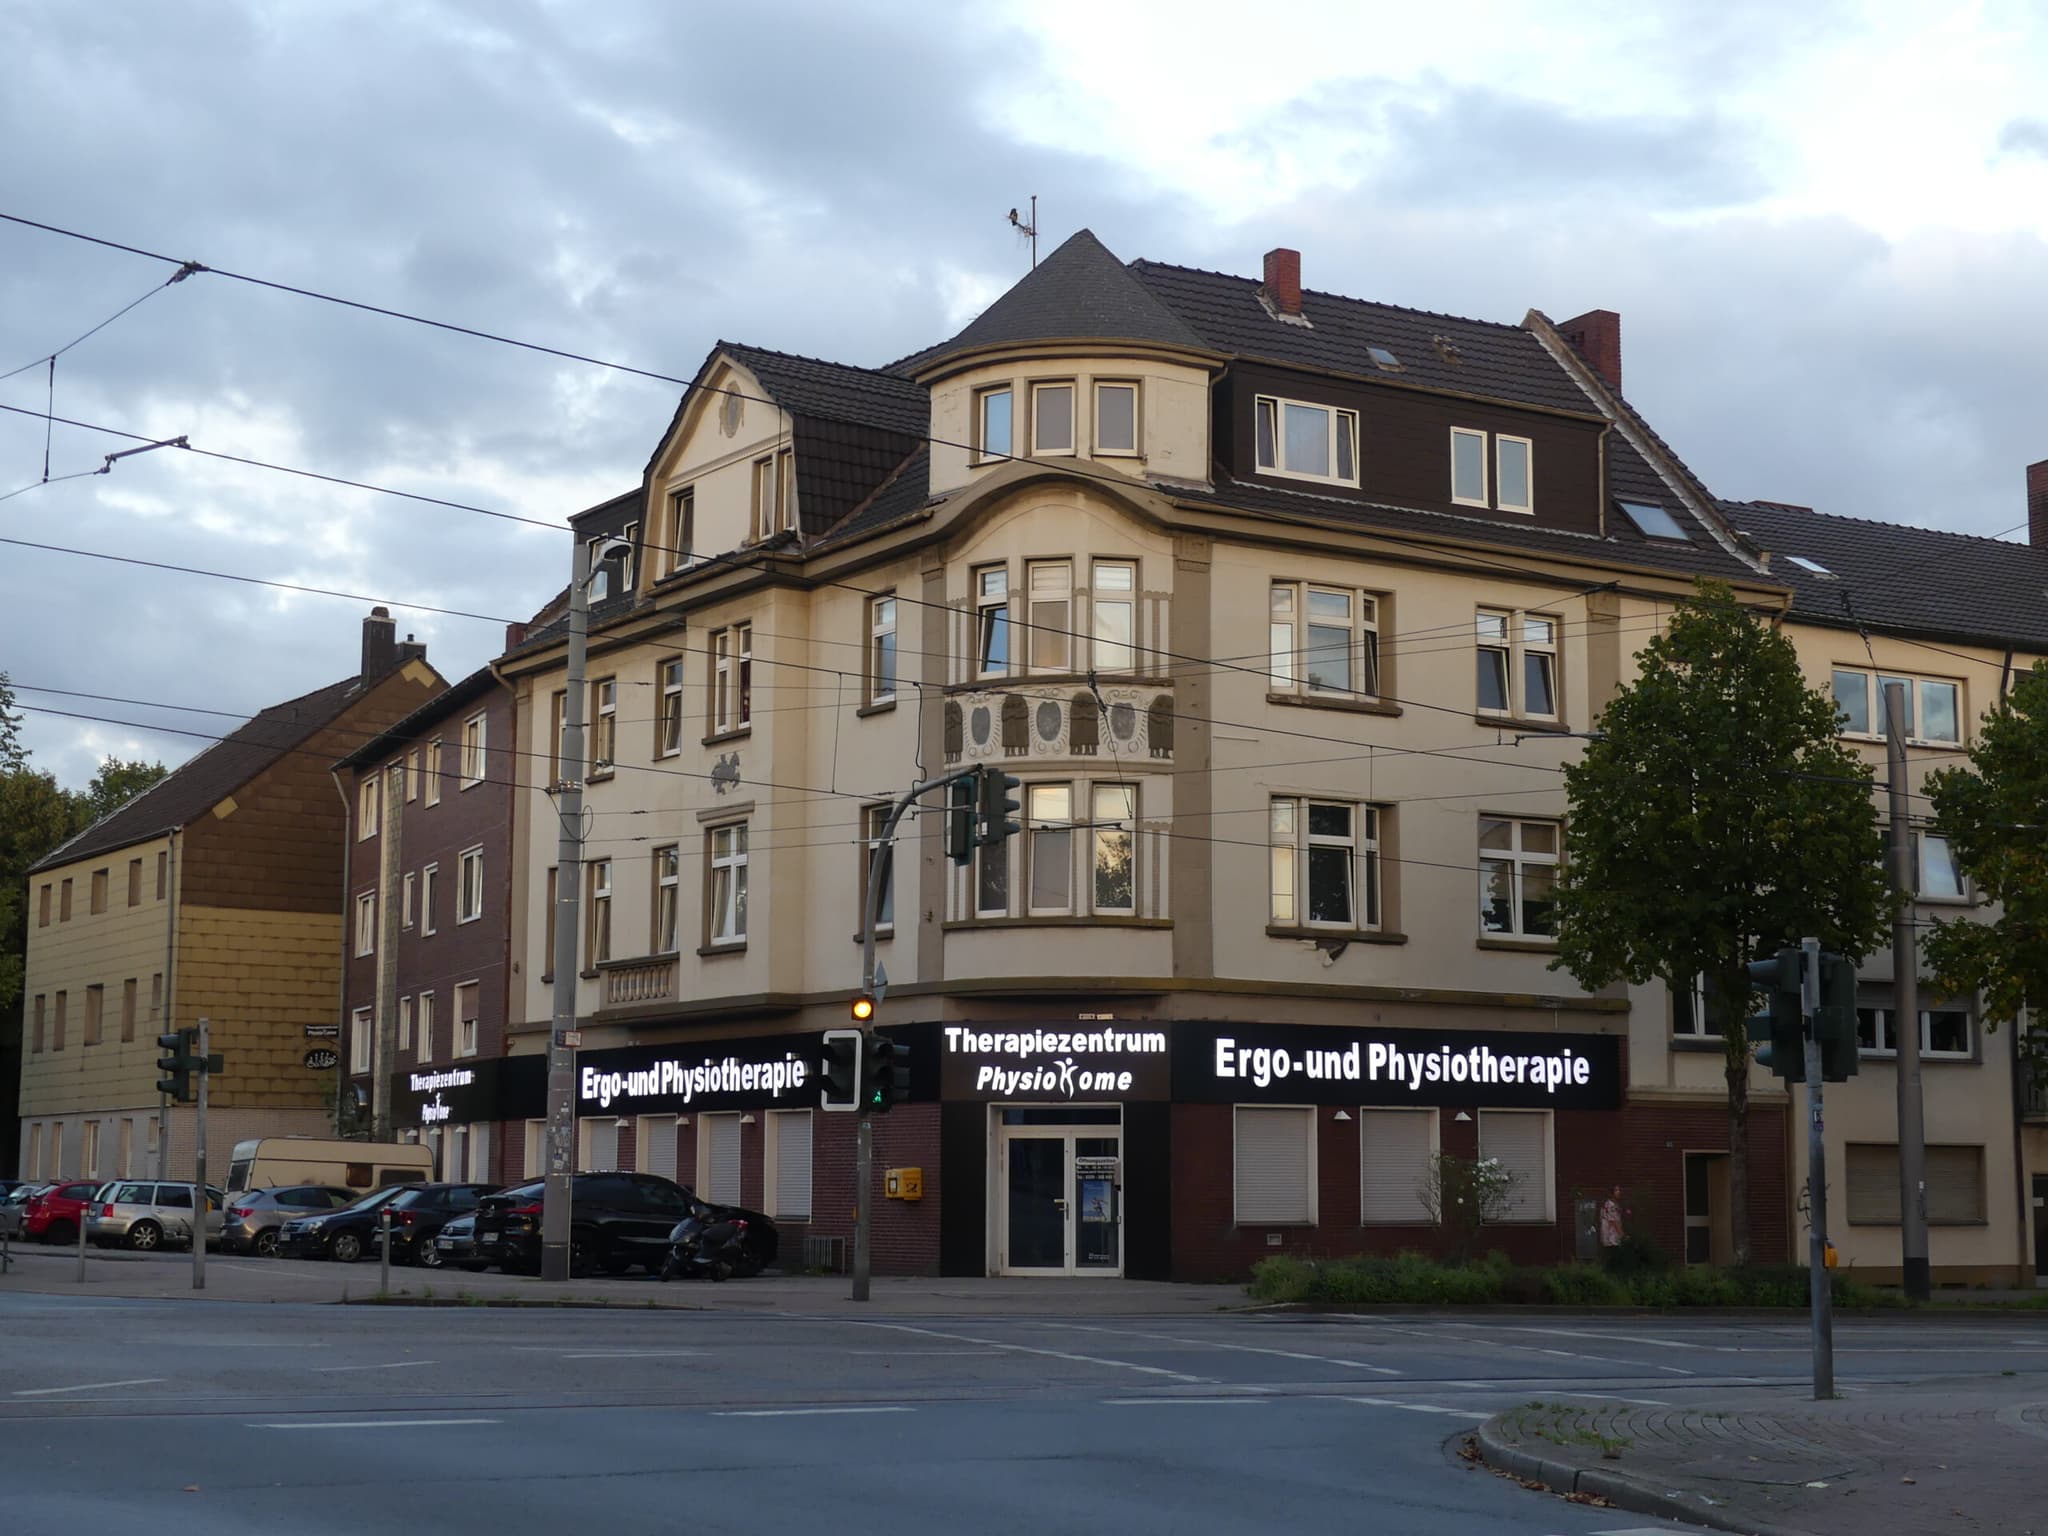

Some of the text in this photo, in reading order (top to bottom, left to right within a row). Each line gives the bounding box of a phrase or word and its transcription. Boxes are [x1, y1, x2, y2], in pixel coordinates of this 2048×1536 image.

[945, 1028, 1166, 1058] Therapiezentrum
[411, 1069, 472, 1093] Therapiezentrum
[582, 1052, 805, 1107] Ergo-und Physiotherapie
[1216, 1038, 1591, 1094] Ergo-und Physiotherapie
